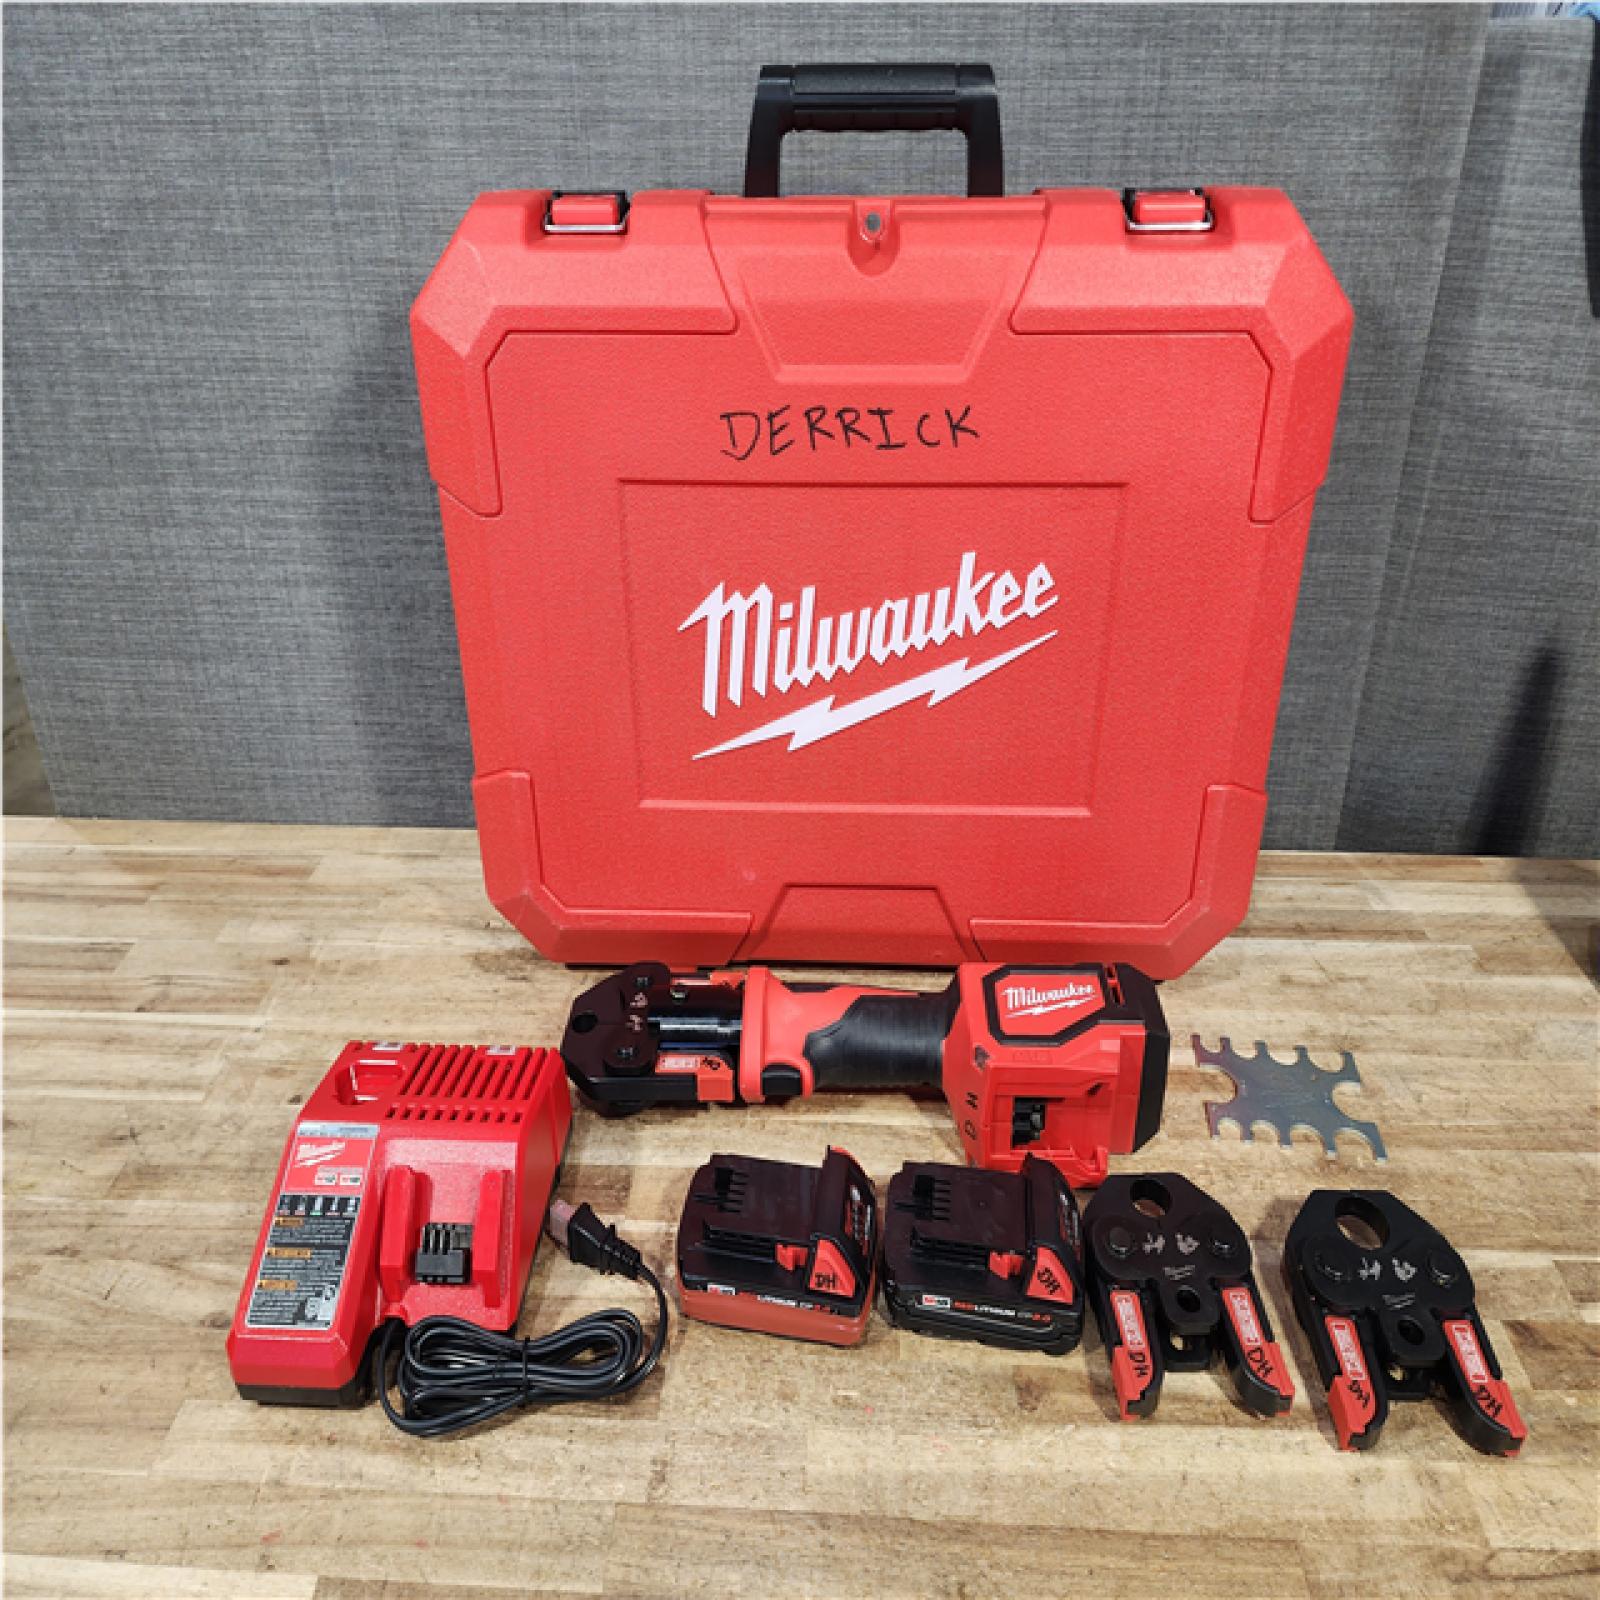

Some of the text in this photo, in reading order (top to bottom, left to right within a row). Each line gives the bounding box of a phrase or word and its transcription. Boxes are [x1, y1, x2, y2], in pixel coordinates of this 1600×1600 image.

[720, 404, 980, 461] DERRICK
[677, 551, 1060, 718] Milwaukee
[1000, 982, 1096, 1010] Milwaukee
